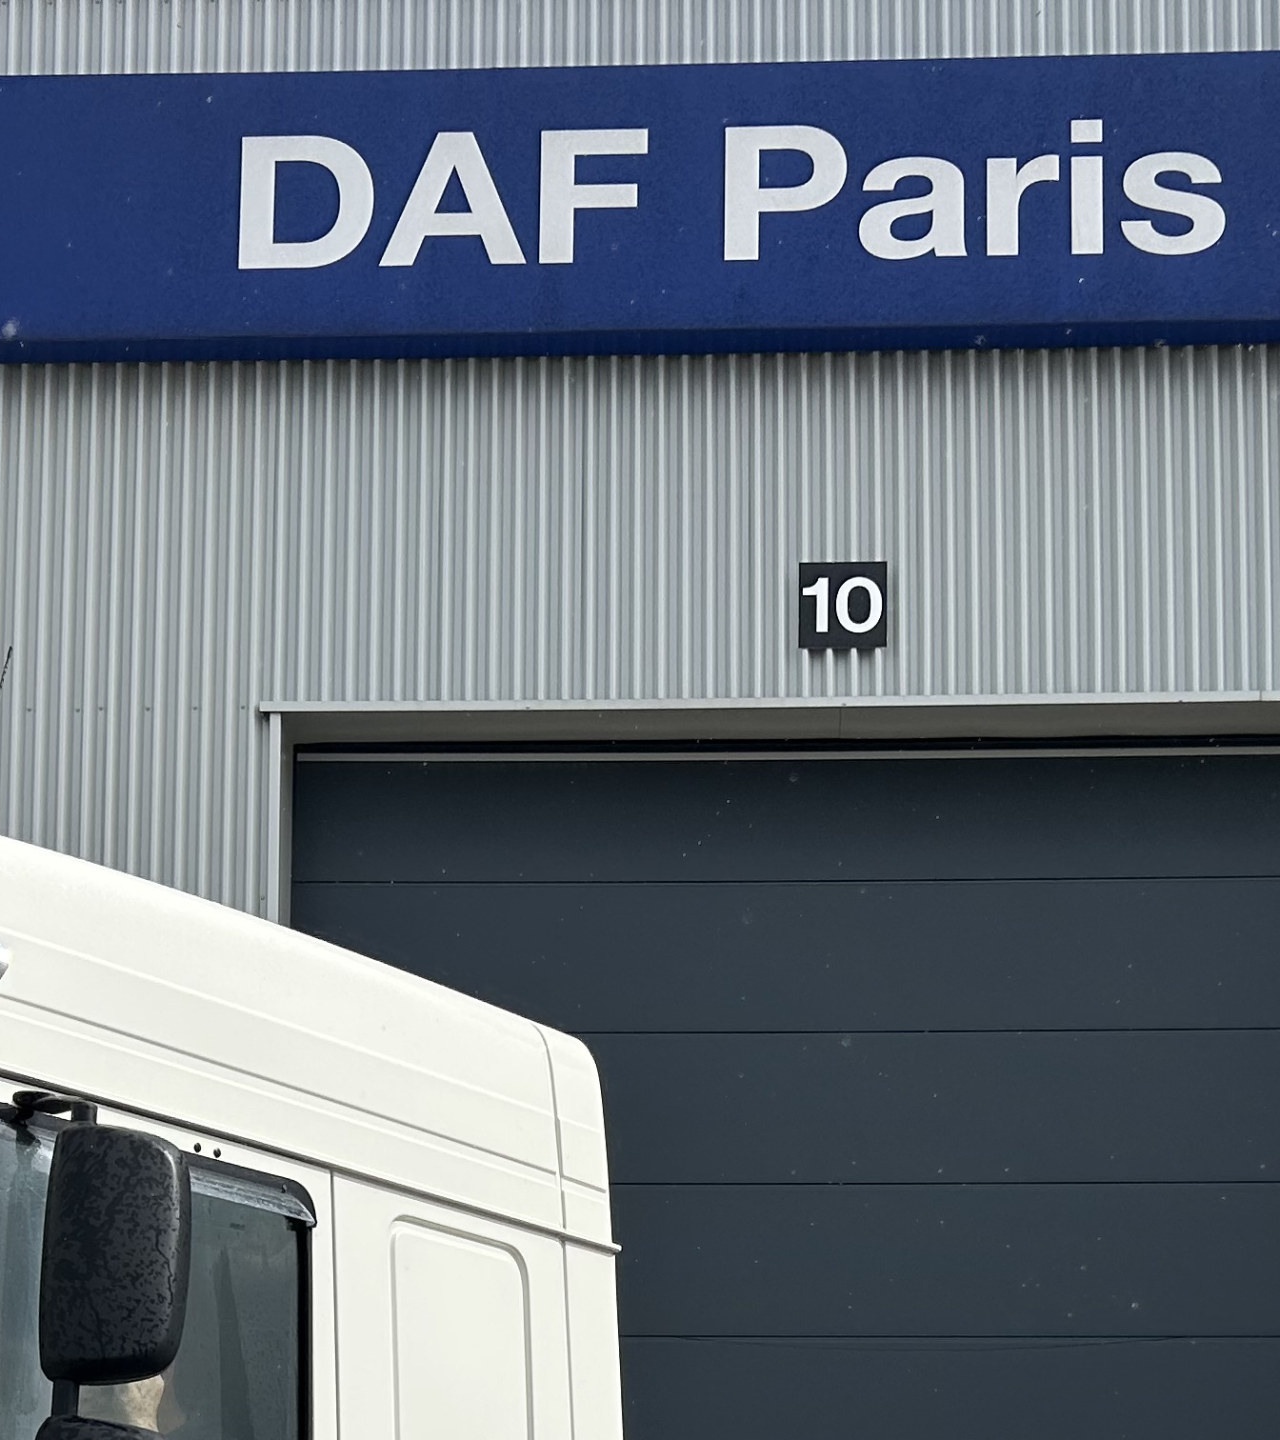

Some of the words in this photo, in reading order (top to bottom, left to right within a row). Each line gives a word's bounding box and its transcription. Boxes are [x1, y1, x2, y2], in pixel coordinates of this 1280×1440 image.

[236, 126, 651, 271] DAF
[722, 118, 1229, 262] Paris
[802, 576, 883, 634] 10
